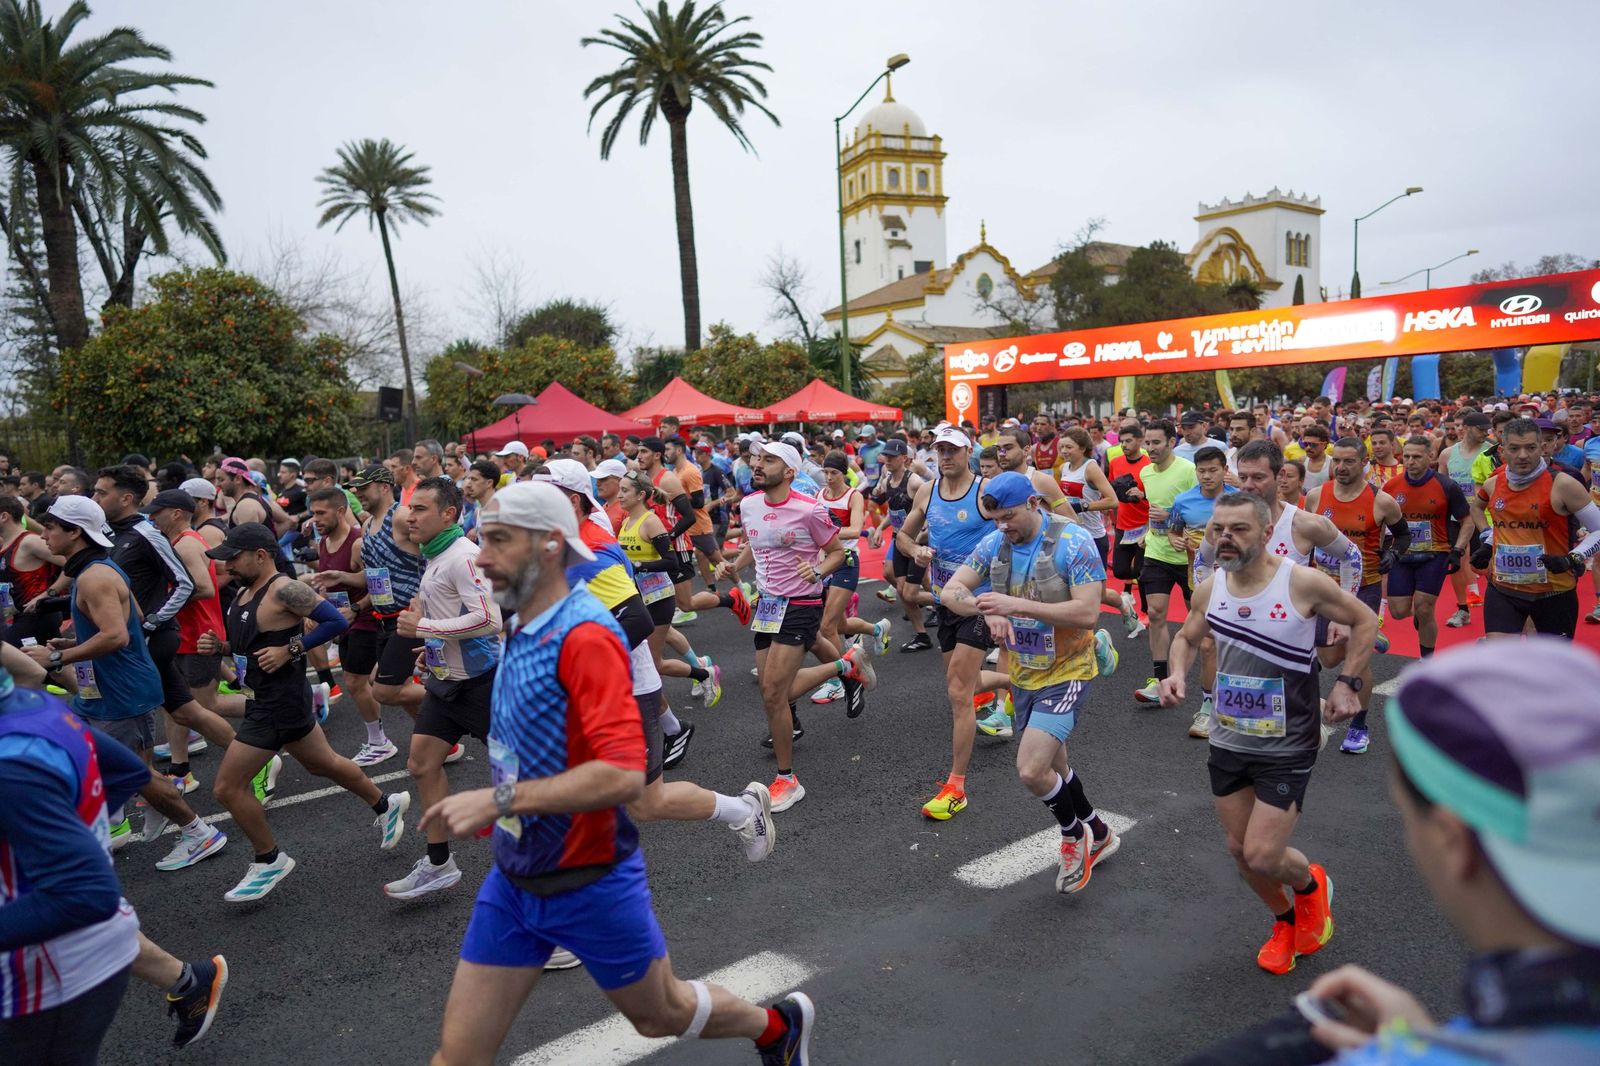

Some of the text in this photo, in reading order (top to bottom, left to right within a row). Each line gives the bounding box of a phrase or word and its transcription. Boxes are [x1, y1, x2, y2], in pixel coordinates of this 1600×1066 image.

[1213, 319, 1293, 341] maratón
[1403, 306, 1477, 333] HOKA
[1490, 314, 1550, 328] HYUNDAI
[1501, 555, 1532, 567] 1808
[1224, 689, 1267, 710] 2494
